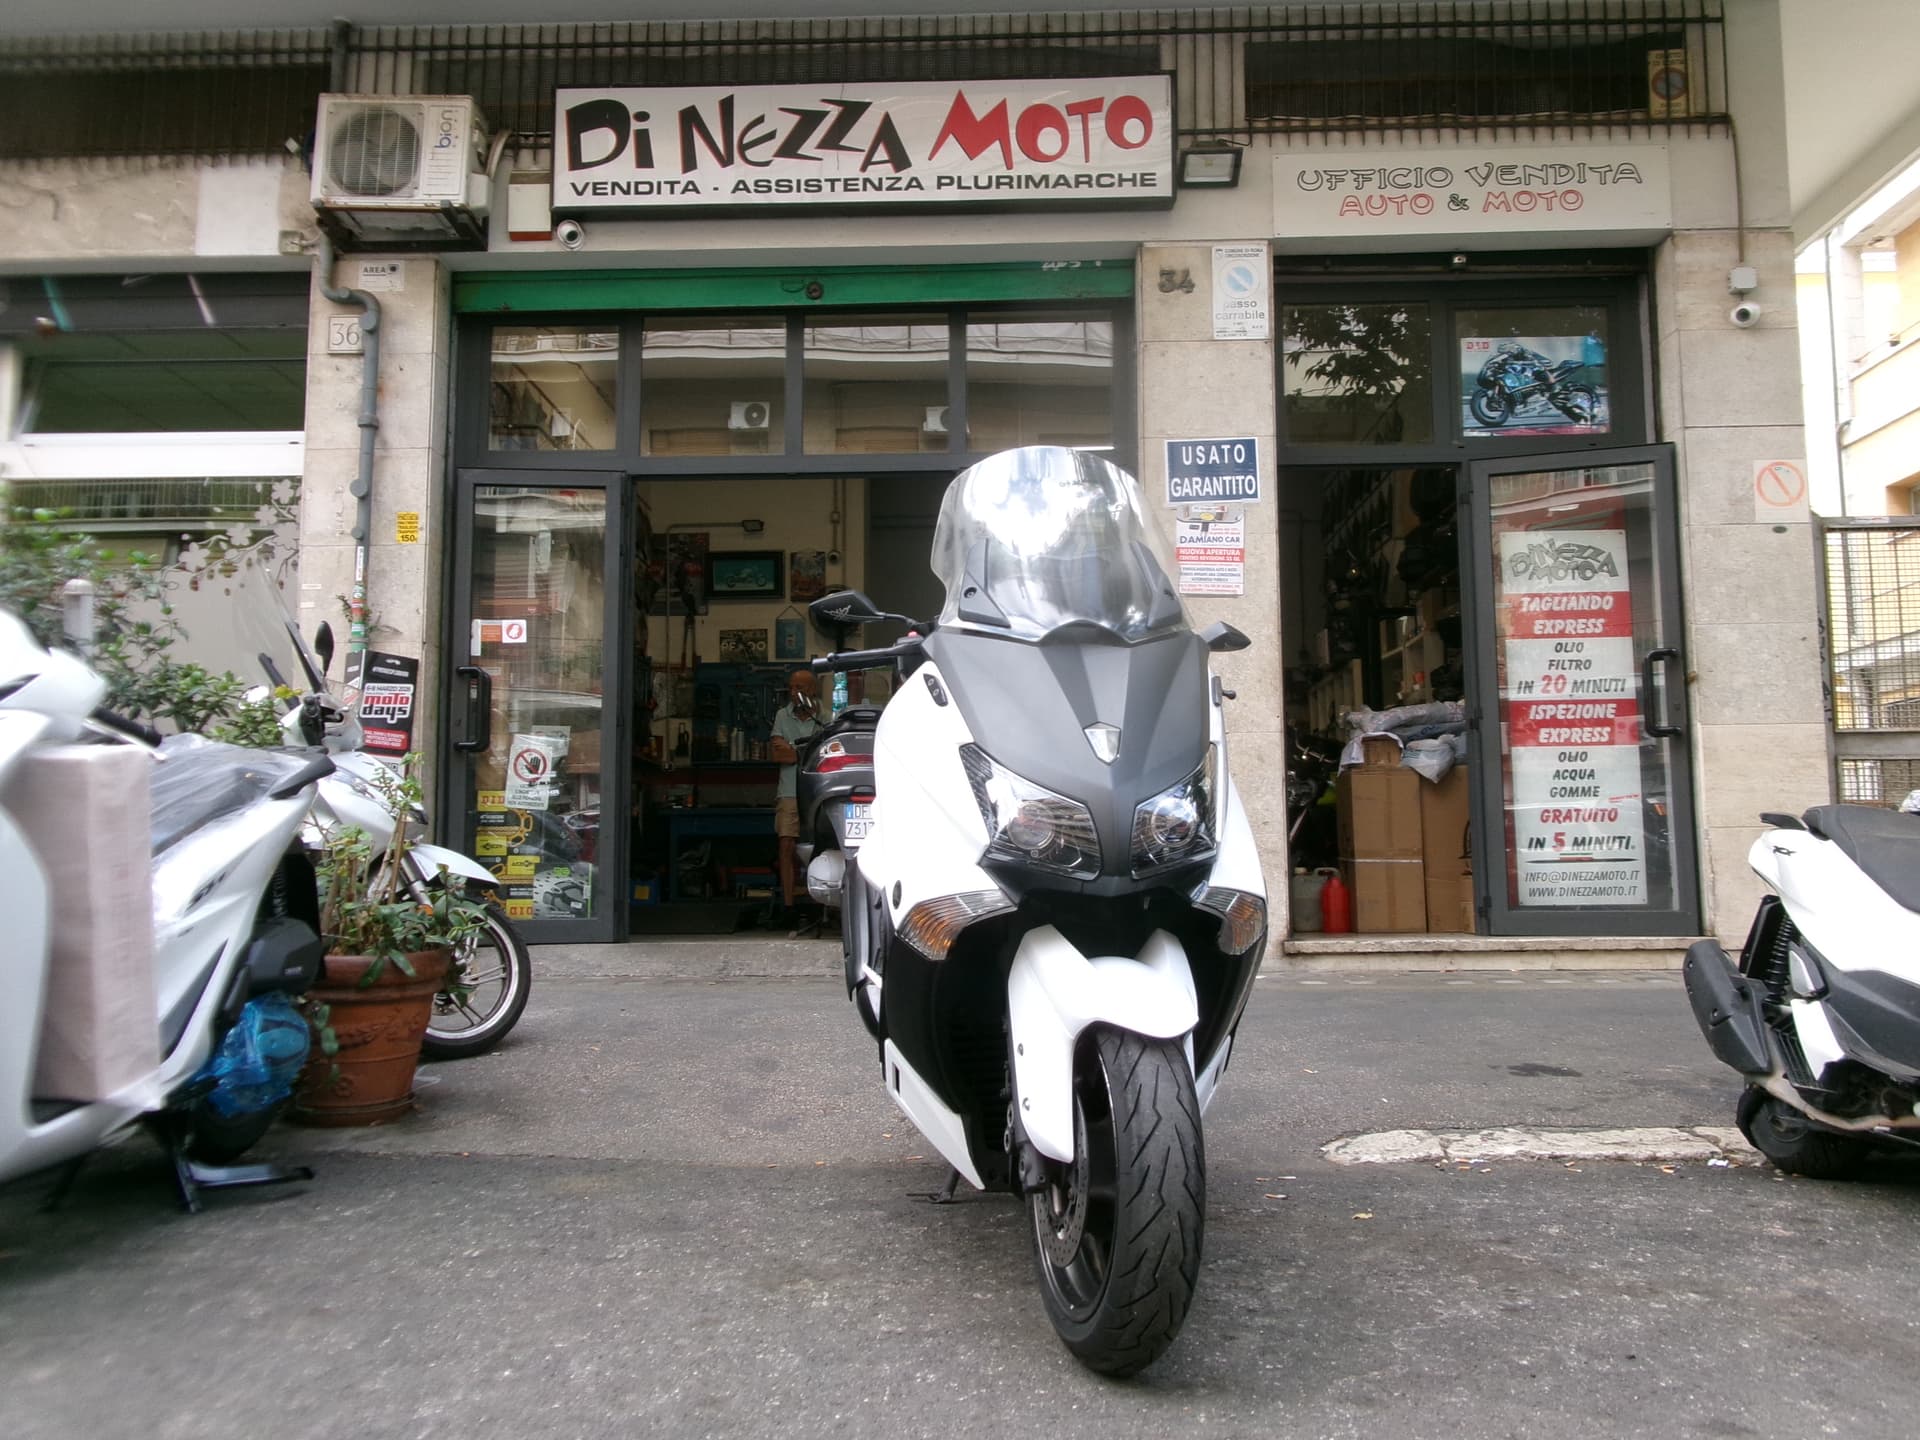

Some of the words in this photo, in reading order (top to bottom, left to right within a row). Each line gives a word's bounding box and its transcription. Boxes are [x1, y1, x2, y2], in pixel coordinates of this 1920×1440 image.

[565, 99, 655, 172] Di
[928, 89, 1153, 170] MOTO
[570, 180, 701, 197] VENDITA
[731, 177, 925, 195] ASSISTENZA
[936, 172, 1157, 191] PLURIMARCHE
[1297, 166, 1453, 191] UFFICIO
[1465, 162, 1643, 187] VENDITA
[1339, 194, 1434, 216] AUTO
[1447, 193, 1470, 211] &
[1482, 189, 1584, 212] MOTO
[1158, 267, 1196, 294] 34
[332, 323, 360, 346] 36
[1182, 444, 1246, 466] USATO
[1170, 475, 1257, 497] GARANTITO
[1179, 535, 1224, 544] DAMIANO
[1225, 536, 1241, 544] CAR
[1519, 595, 1615, 612] TAGLIANDO
[1533, 618, 1606, 635] EXPRESS
[1554, 642, 1585, 654] OLIO
[1548, 659, 1593, 671] FILTRO
[1516, 681, 1535, 694] IN
[1540, 674, 1568, 694] 20
[1570, 678, 1627, 693] MINUTI
[364, 692, 411, 705] moto
[362, 704, 409, 722] days
[1529, 703, 1617, 720] ISPEZIONE
[1538, 727, 1611, 744] EXPRESS
[1558, 751, 1589, 763] OLIO
[1552, 769, 1596, 781] ACQUA
[1550, 786, 1601, 798] GOMME
[1540, 808, 1619, 824] GRATUITO
[1528, 837, 1547, 850] IN
[1552, 832, 1567, 852] 5
[1525, 870, 1640, 883] INFO@DINEZZAMOTO.IT
[1528, 886, 1639, 898] WWW.DINEZZAMOTO.IT
